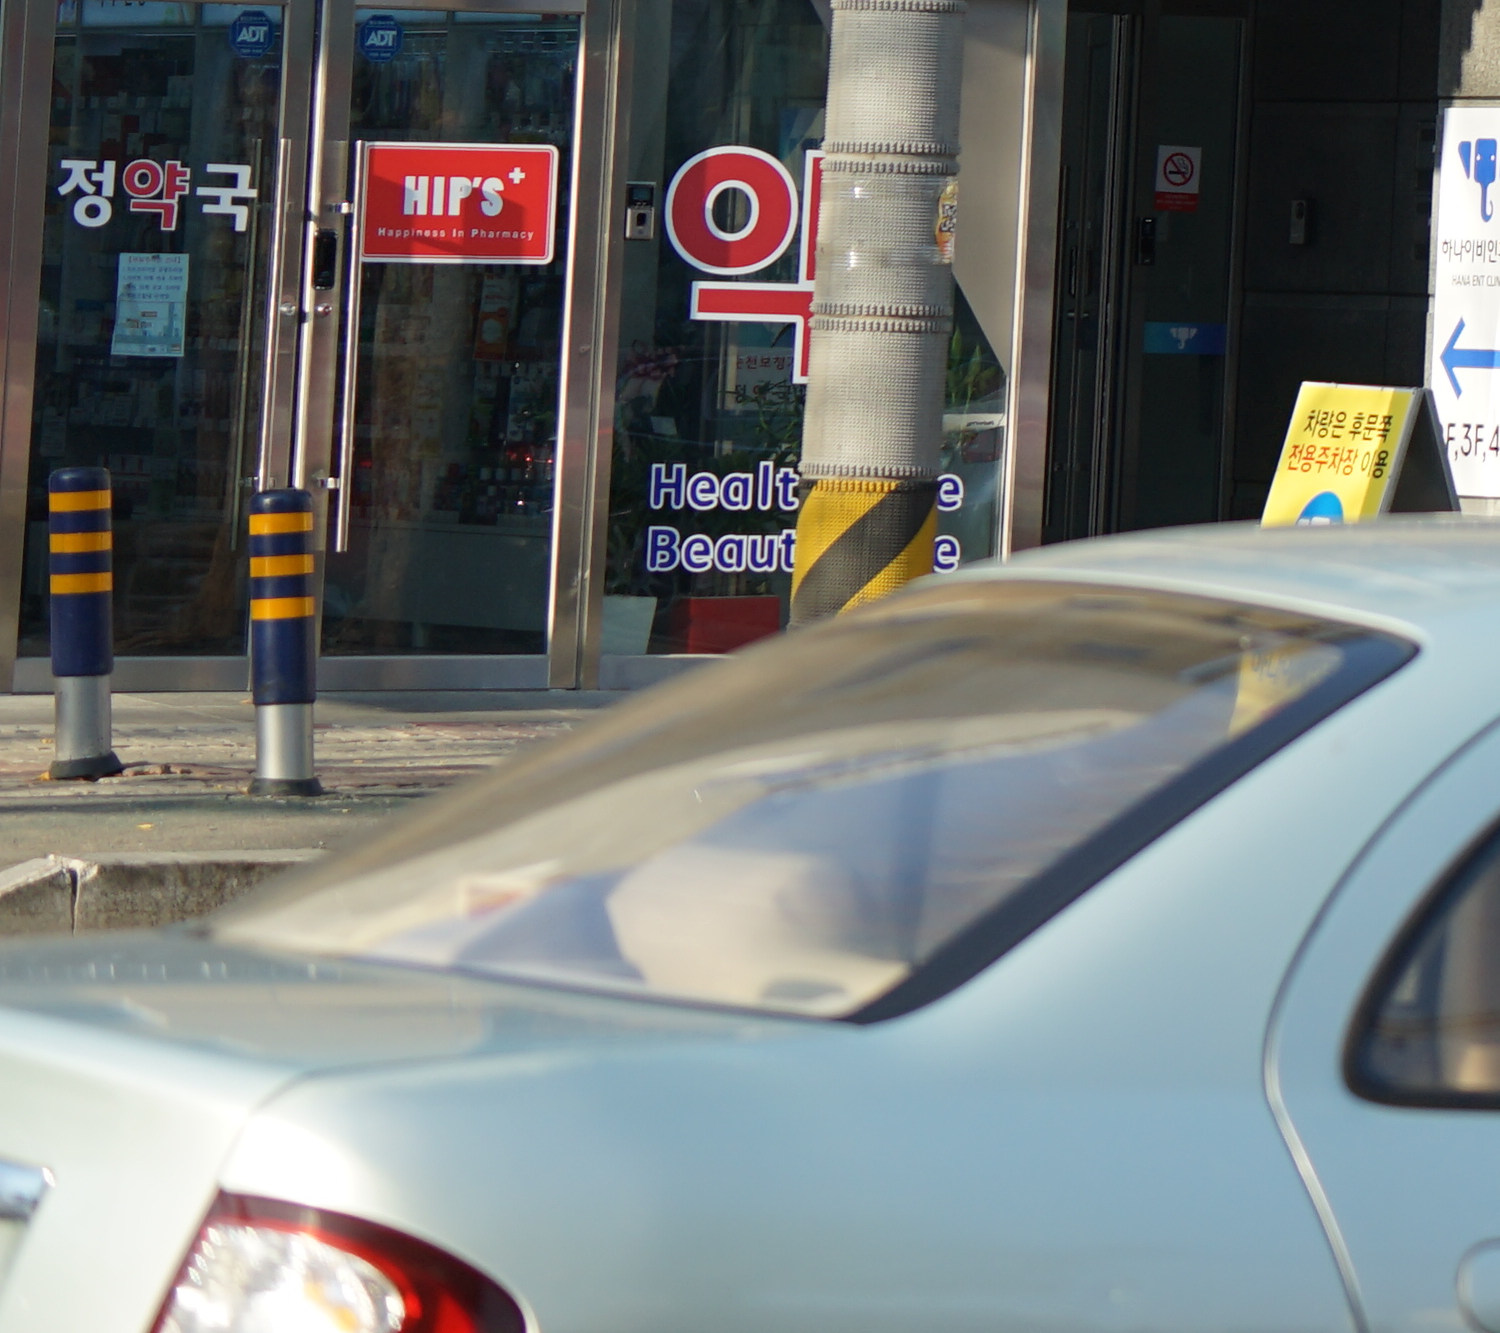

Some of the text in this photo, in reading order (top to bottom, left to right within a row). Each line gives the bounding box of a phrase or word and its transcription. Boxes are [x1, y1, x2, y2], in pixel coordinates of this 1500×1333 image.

[236, 25, 269, 43] ADT
[365, 29, 398, 47] ADT
[56, 158, 259, 232] 정약국
[403, 175, 506, 216] HIP'S
[377, 226, 535, 242] Happiness In Pharmacy
[1451, 273, 1472, 286] HANA
[1472, 274, 1486, 287] ENT
[1304, 408, 1394, 444] 차량은 후문쪽
[1286, 442, 1389, 480] 전용주차장 이용
[650, 460, 800, 512] Healt
[646, 526, 797, 573] Beaut
